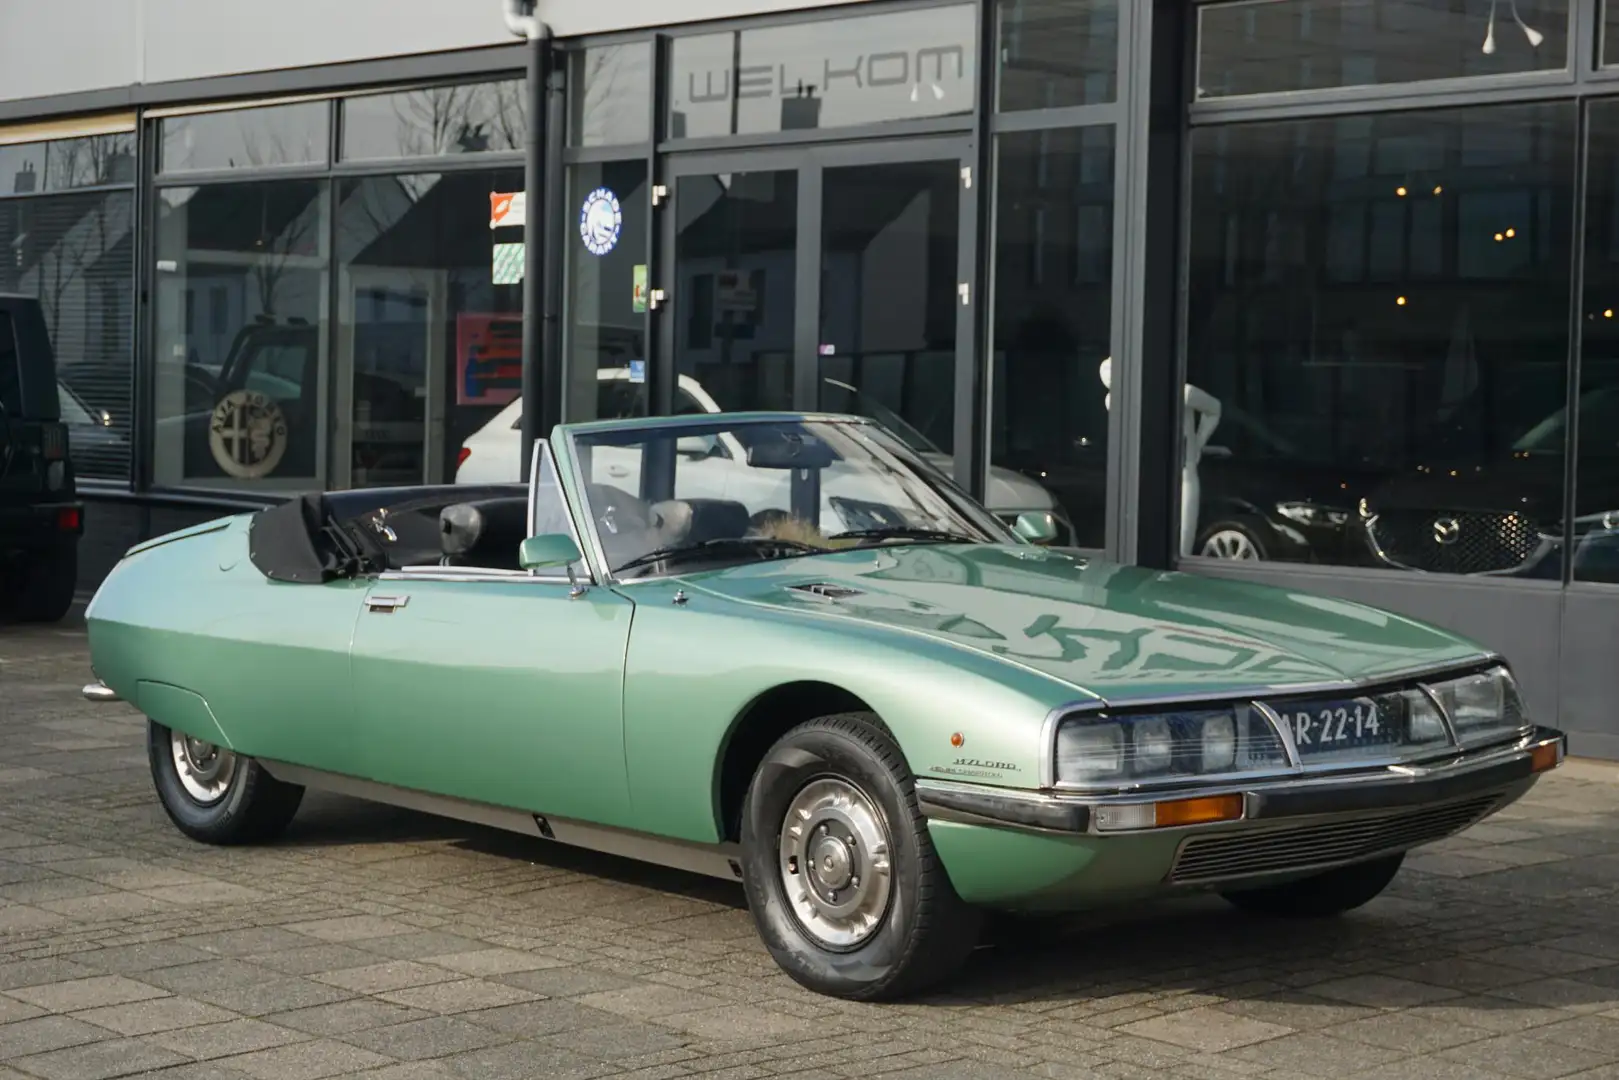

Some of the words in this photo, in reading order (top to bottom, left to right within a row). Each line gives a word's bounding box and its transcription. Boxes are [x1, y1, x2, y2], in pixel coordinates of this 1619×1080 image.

[689, 45, 964, 103] WELKOM
[582, 188, 622, 225] SCHADE
[580, 222, 618, 256] GARANT
